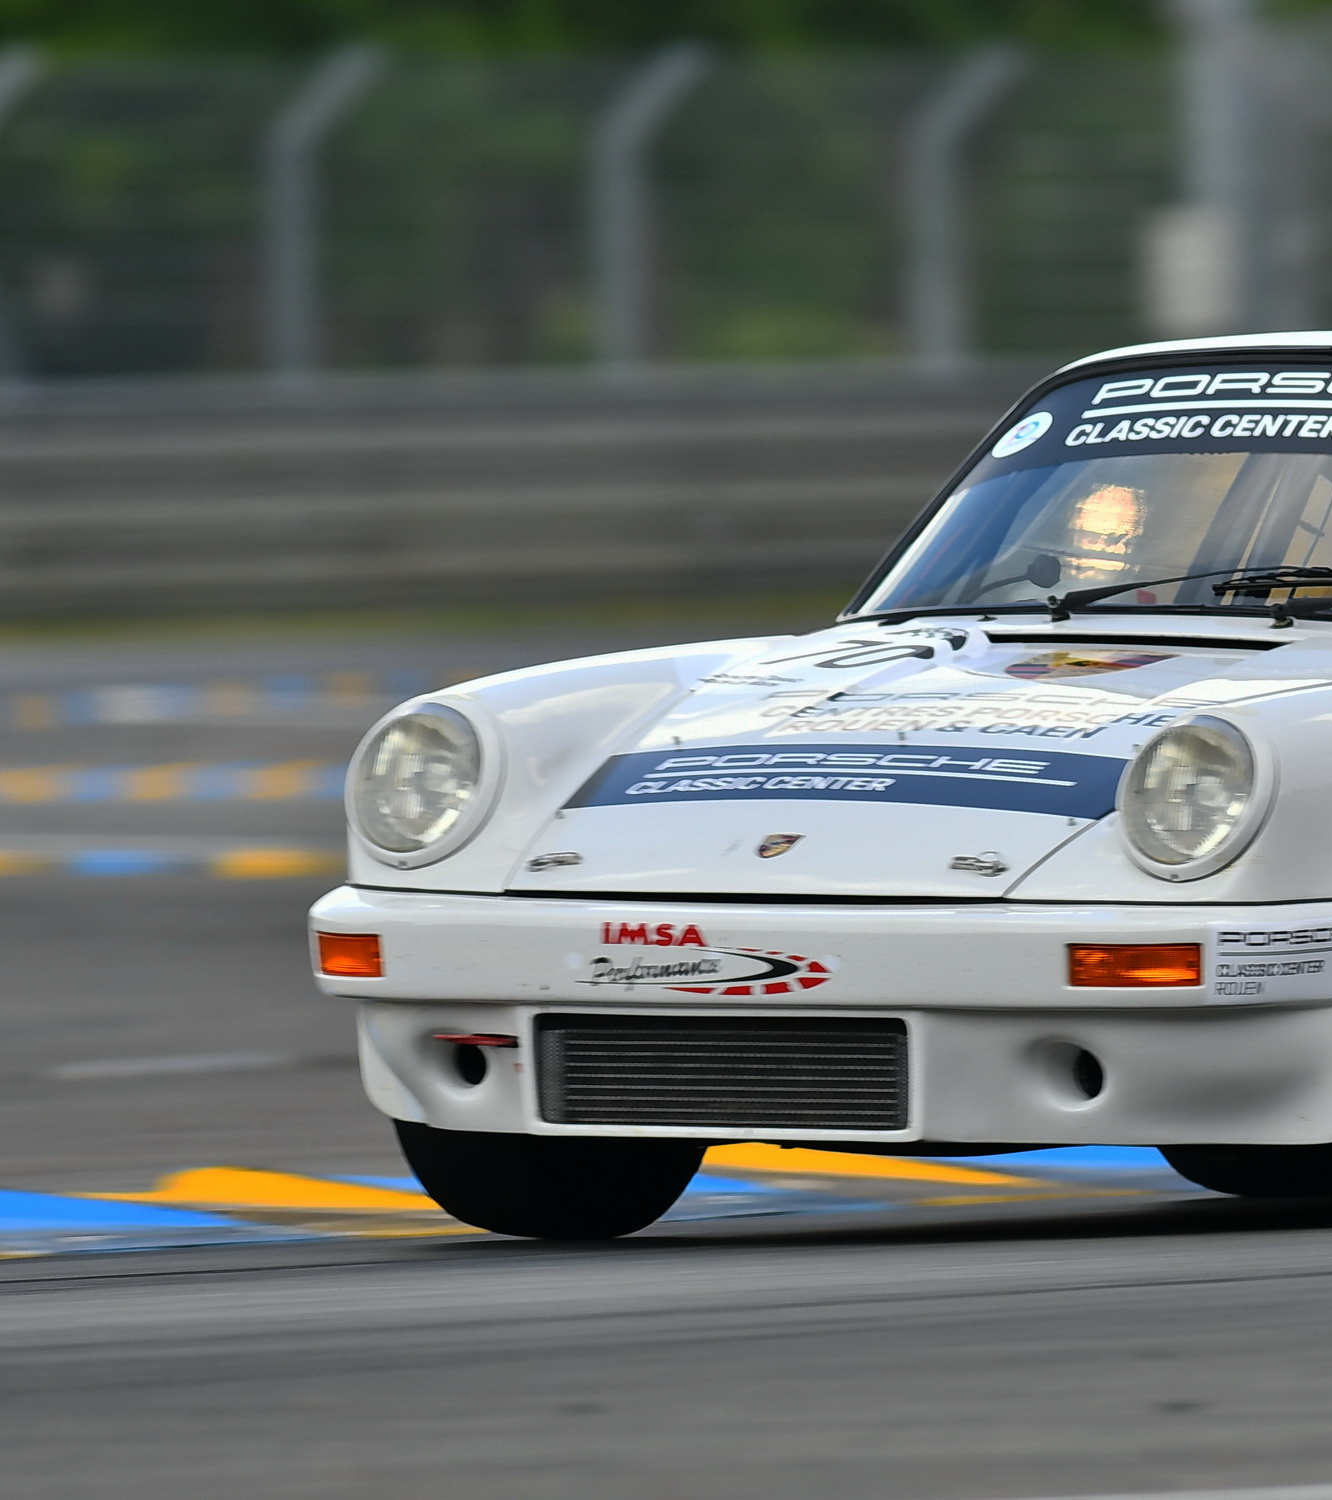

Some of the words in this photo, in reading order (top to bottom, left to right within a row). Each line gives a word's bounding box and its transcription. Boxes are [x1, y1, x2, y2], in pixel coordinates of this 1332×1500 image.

[1064, 413, 1210, 448] CLASSIC
[759, 639, 935, 669] 70
[978, 722, 1108, 739] CAEN
[655, 752, 1052, 774] PORSCHE
[625, 776, 765, 795] CLASSIC
[762, 776, 898, 792] CENTER
